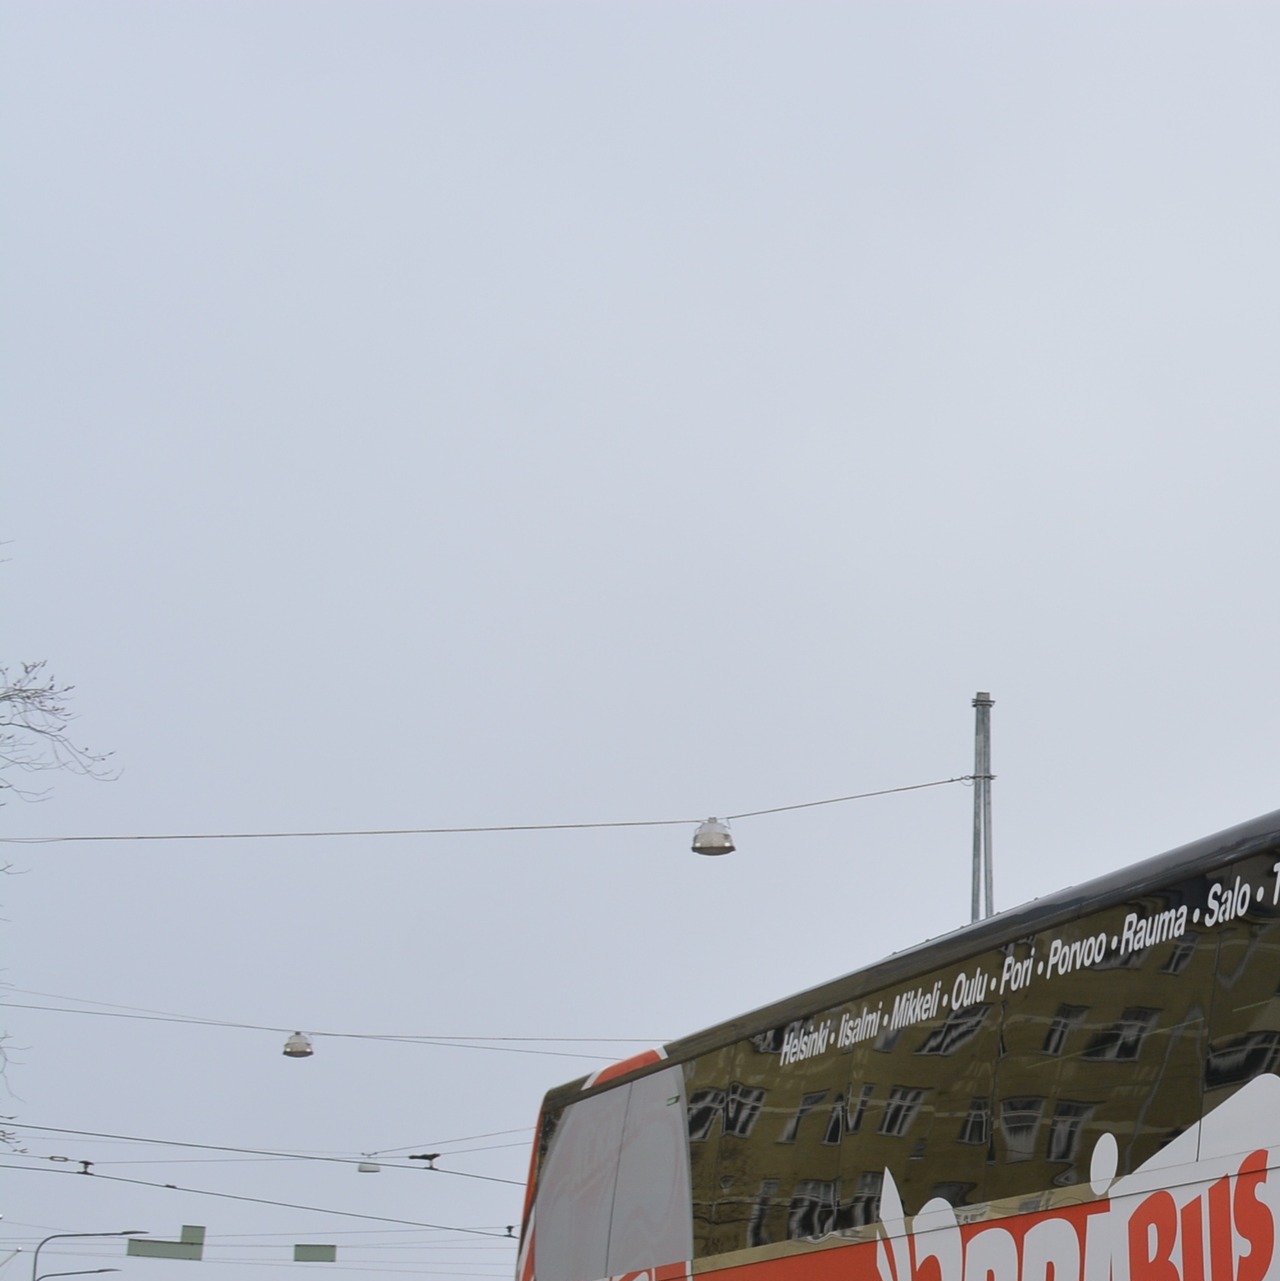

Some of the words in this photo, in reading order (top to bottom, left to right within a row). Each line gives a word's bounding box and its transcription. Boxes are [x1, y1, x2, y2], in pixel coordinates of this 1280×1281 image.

[780, 1020, 830, 1066] Helsinki
[837, 1001, 882, 1049] Iisalmi
[890, 981, 941, 1031] Mikkeli
[951, 967, 989, 1010] Oulu
[1000, 949, 1034, 995] Pori
[1046, 932, 1107, 979] Porvoo
[1119, 904, 1187, 955] Rauma
[1204, 876, 1250, 927] Salo
